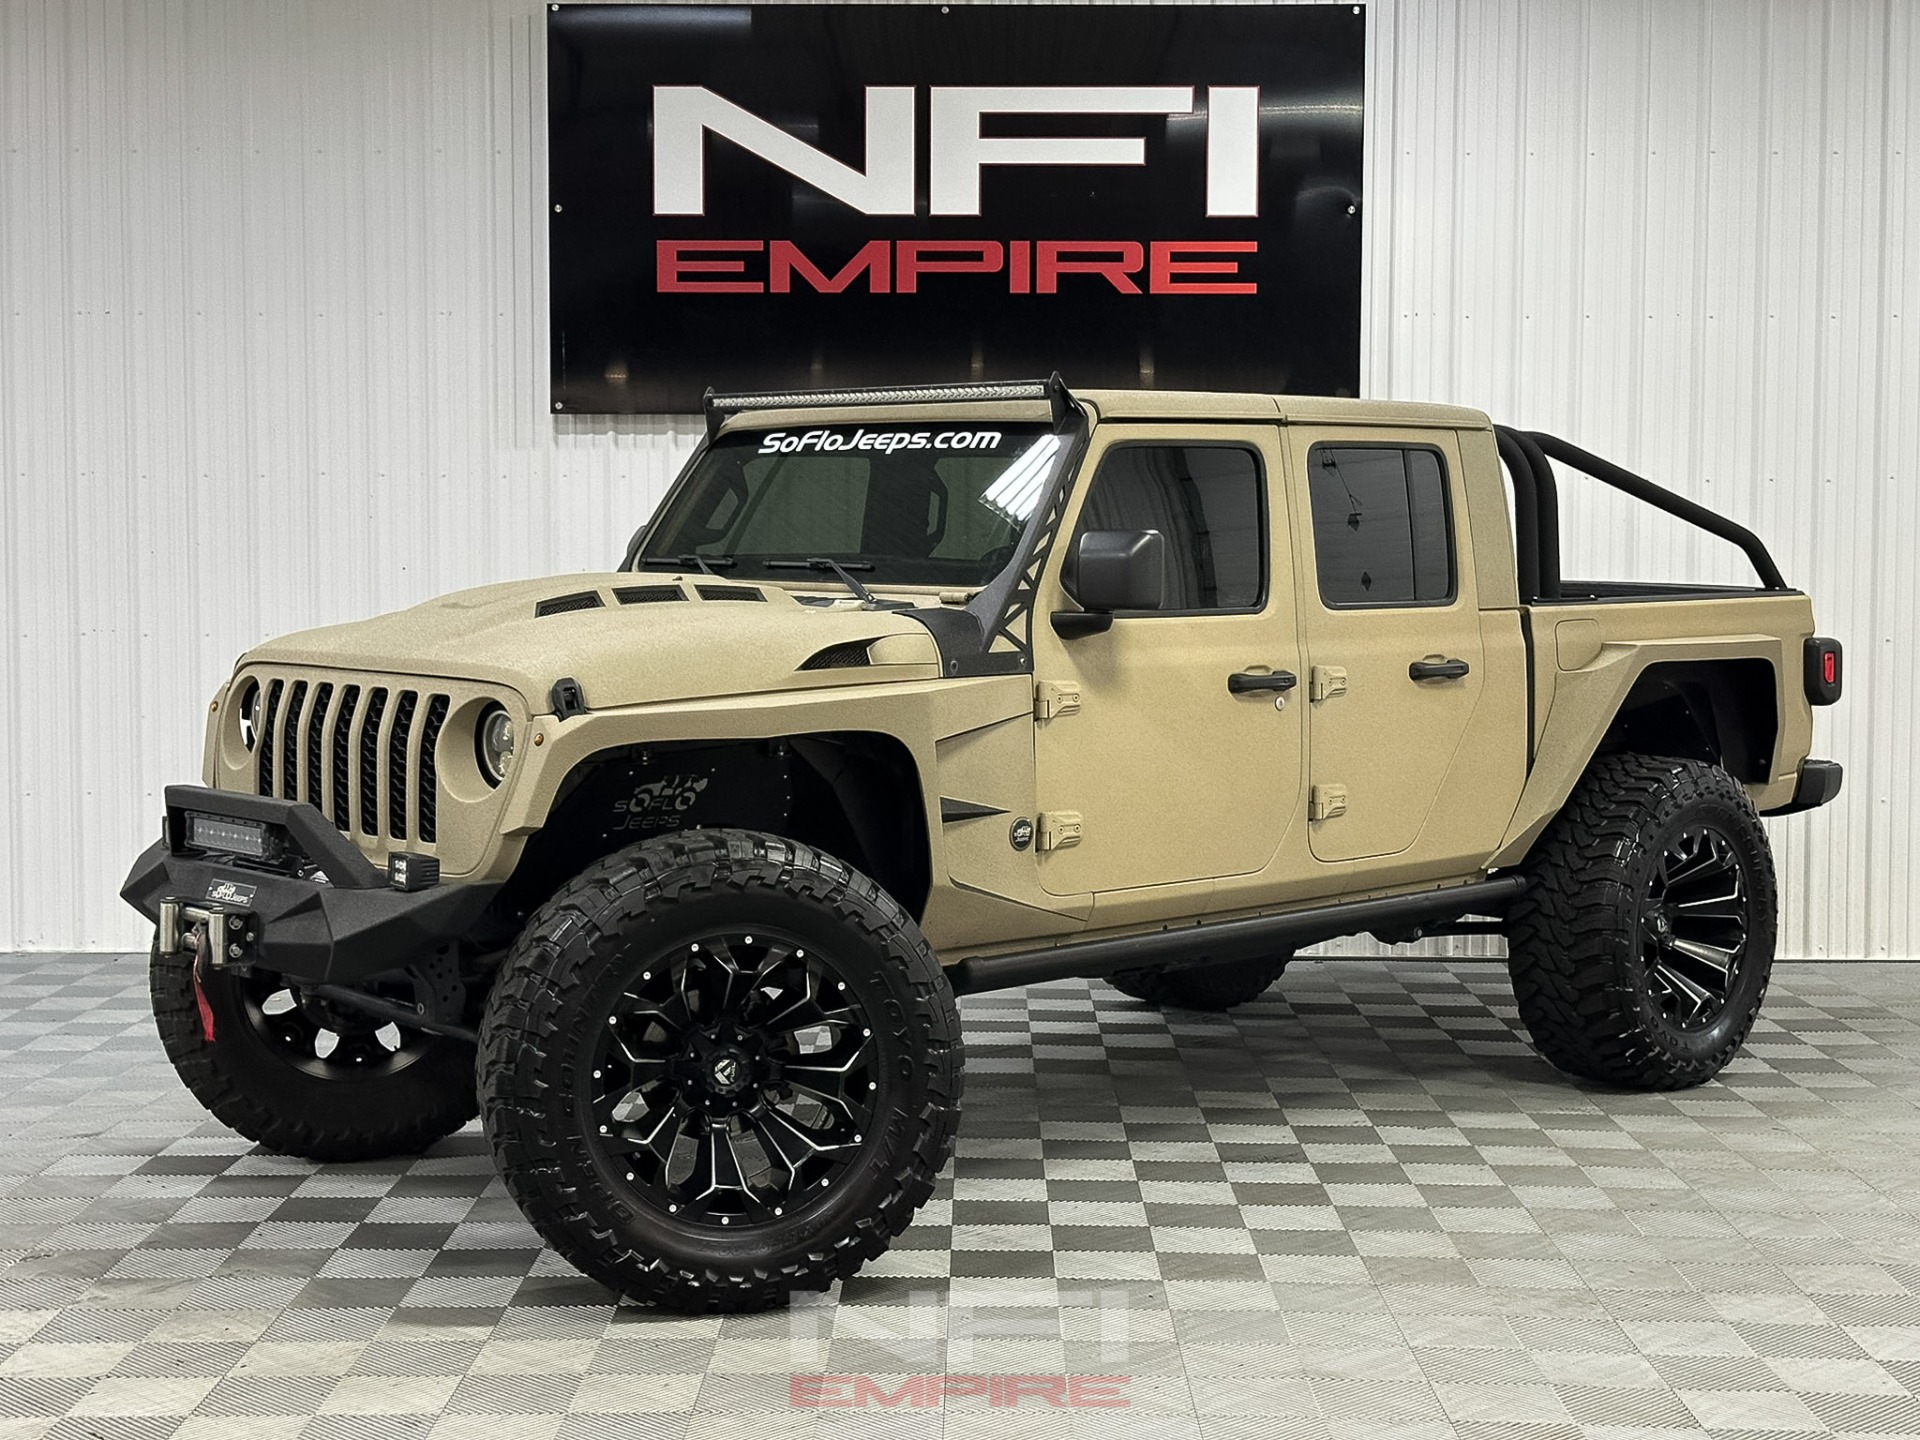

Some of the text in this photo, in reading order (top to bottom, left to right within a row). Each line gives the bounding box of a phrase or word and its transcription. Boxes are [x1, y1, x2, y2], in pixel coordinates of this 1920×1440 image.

[653, 85, 1260, 217] NFI
[656, 239, 1258, 294] EMPIRE
[870, 970, 915, 1081] TOYO
